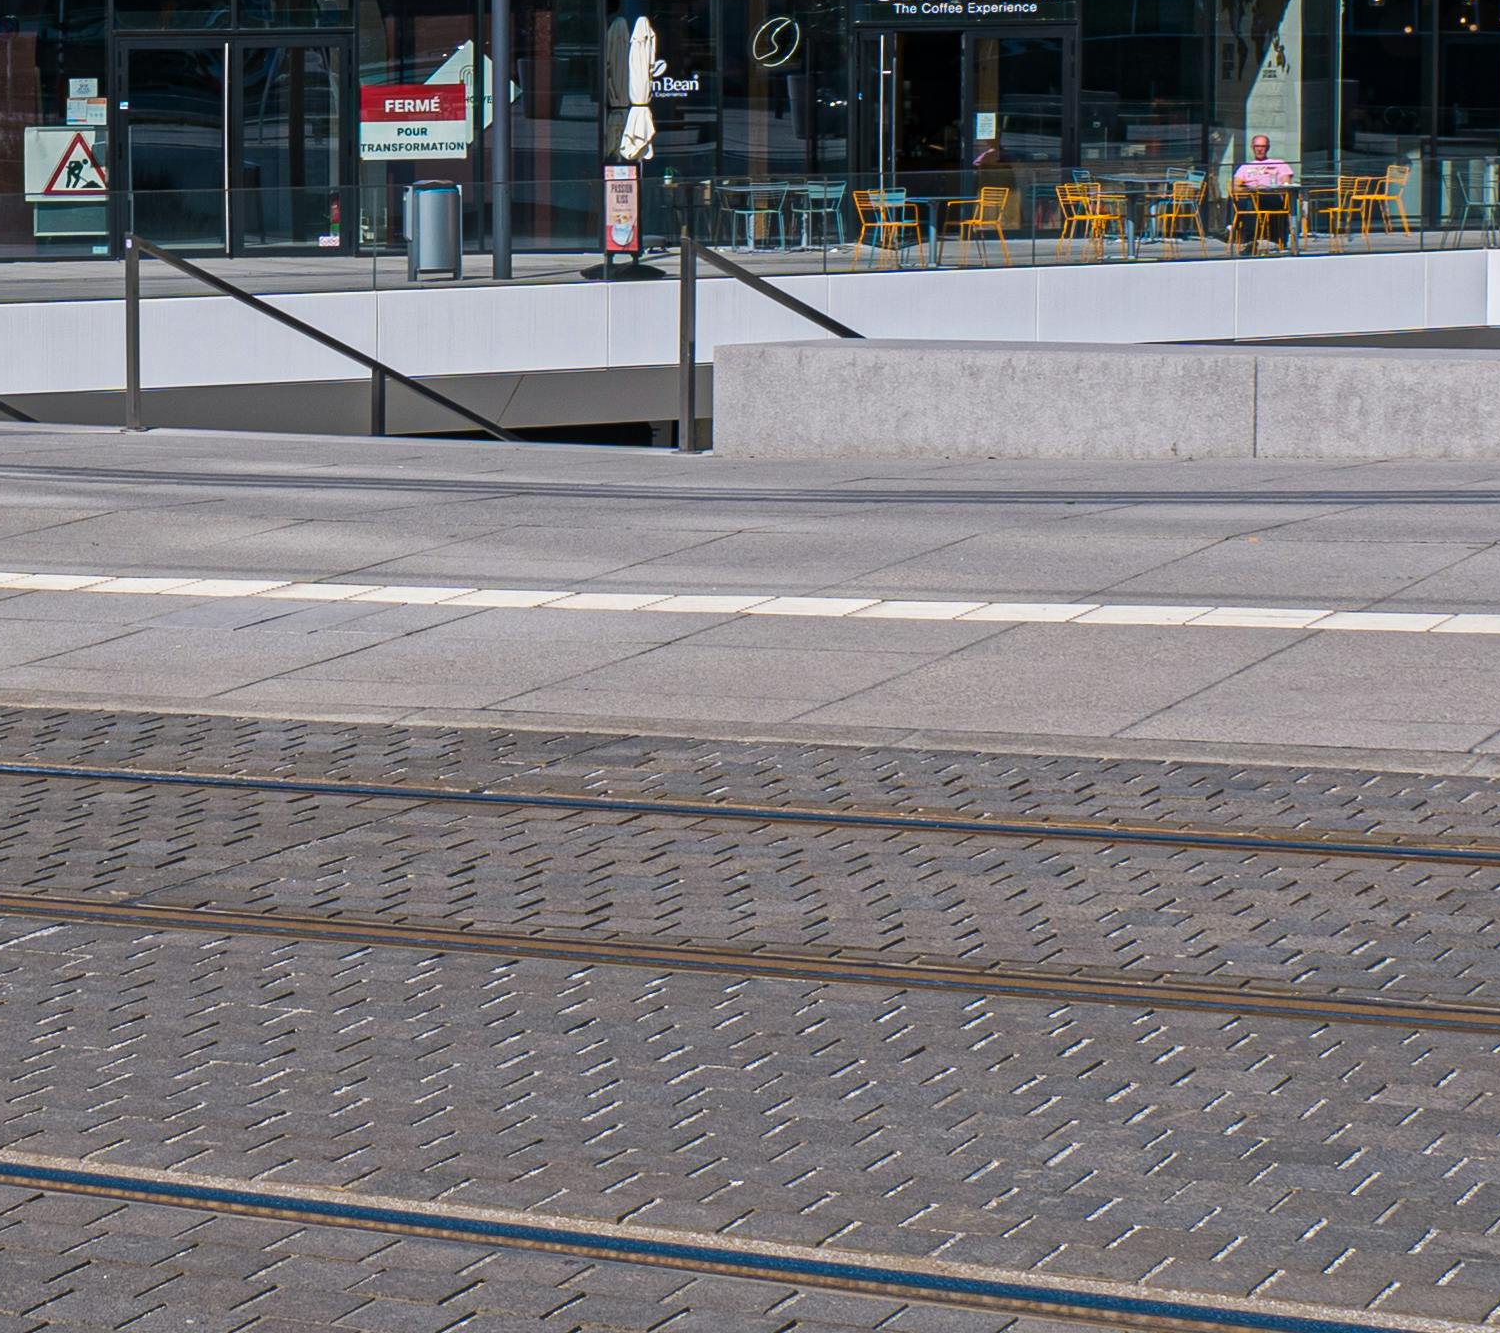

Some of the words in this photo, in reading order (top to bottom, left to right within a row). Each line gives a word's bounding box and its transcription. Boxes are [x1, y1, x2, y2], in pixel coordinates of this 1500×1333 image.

[894, 3, 917, 14] The
[921, 2, 963, 14] Coffee
[967, 2, 1038, 16] Experience
[663, 77, 699, 91] Bean
[384, 96, 441, 113] FERMÉ
[397, 127, 428, 137] POUR
[360, 142, 465, 152] TRANSFORMATION
